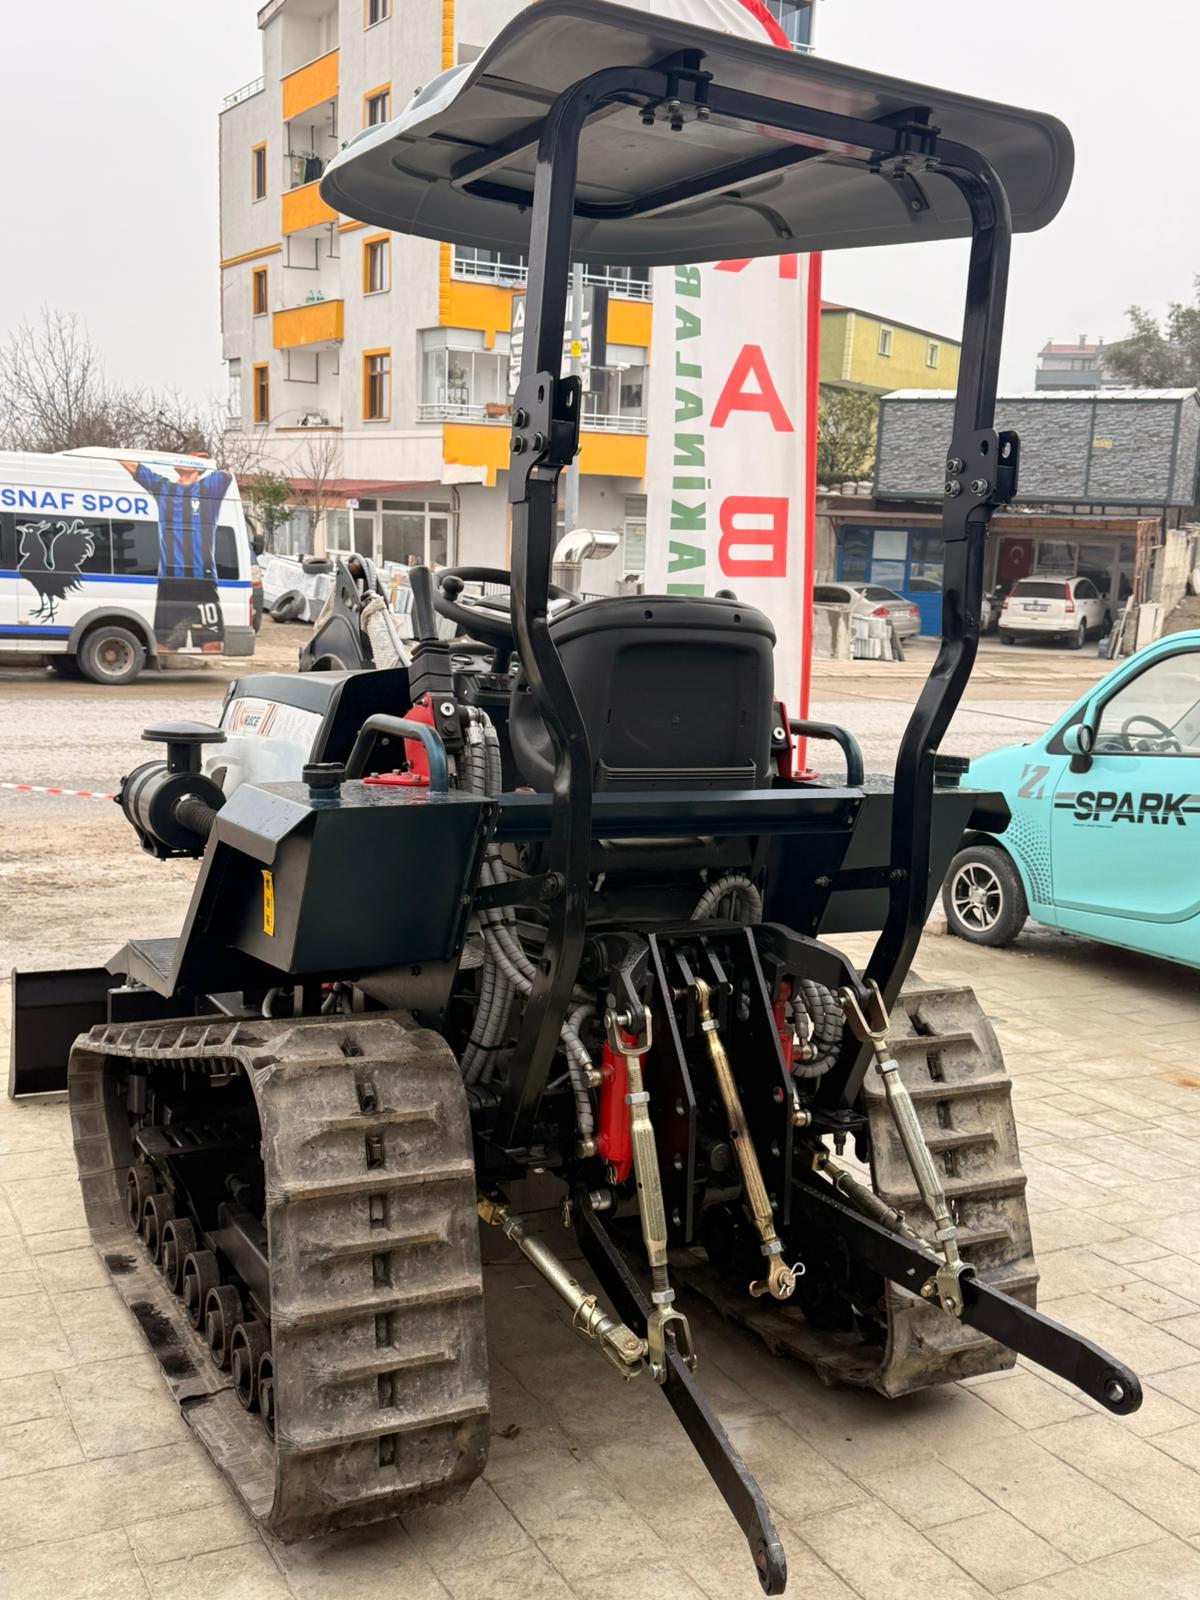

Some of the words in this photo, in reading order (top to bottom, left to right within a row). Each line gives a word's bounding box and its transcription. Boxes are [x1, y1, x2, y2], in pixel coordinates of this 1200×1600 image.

[1, 488, 75, 509] SNAF
[82, 494, 149, 515] SPOR
[197, 602, 218, 625] 10
[1073, 790, 1192, 826] SPARK
